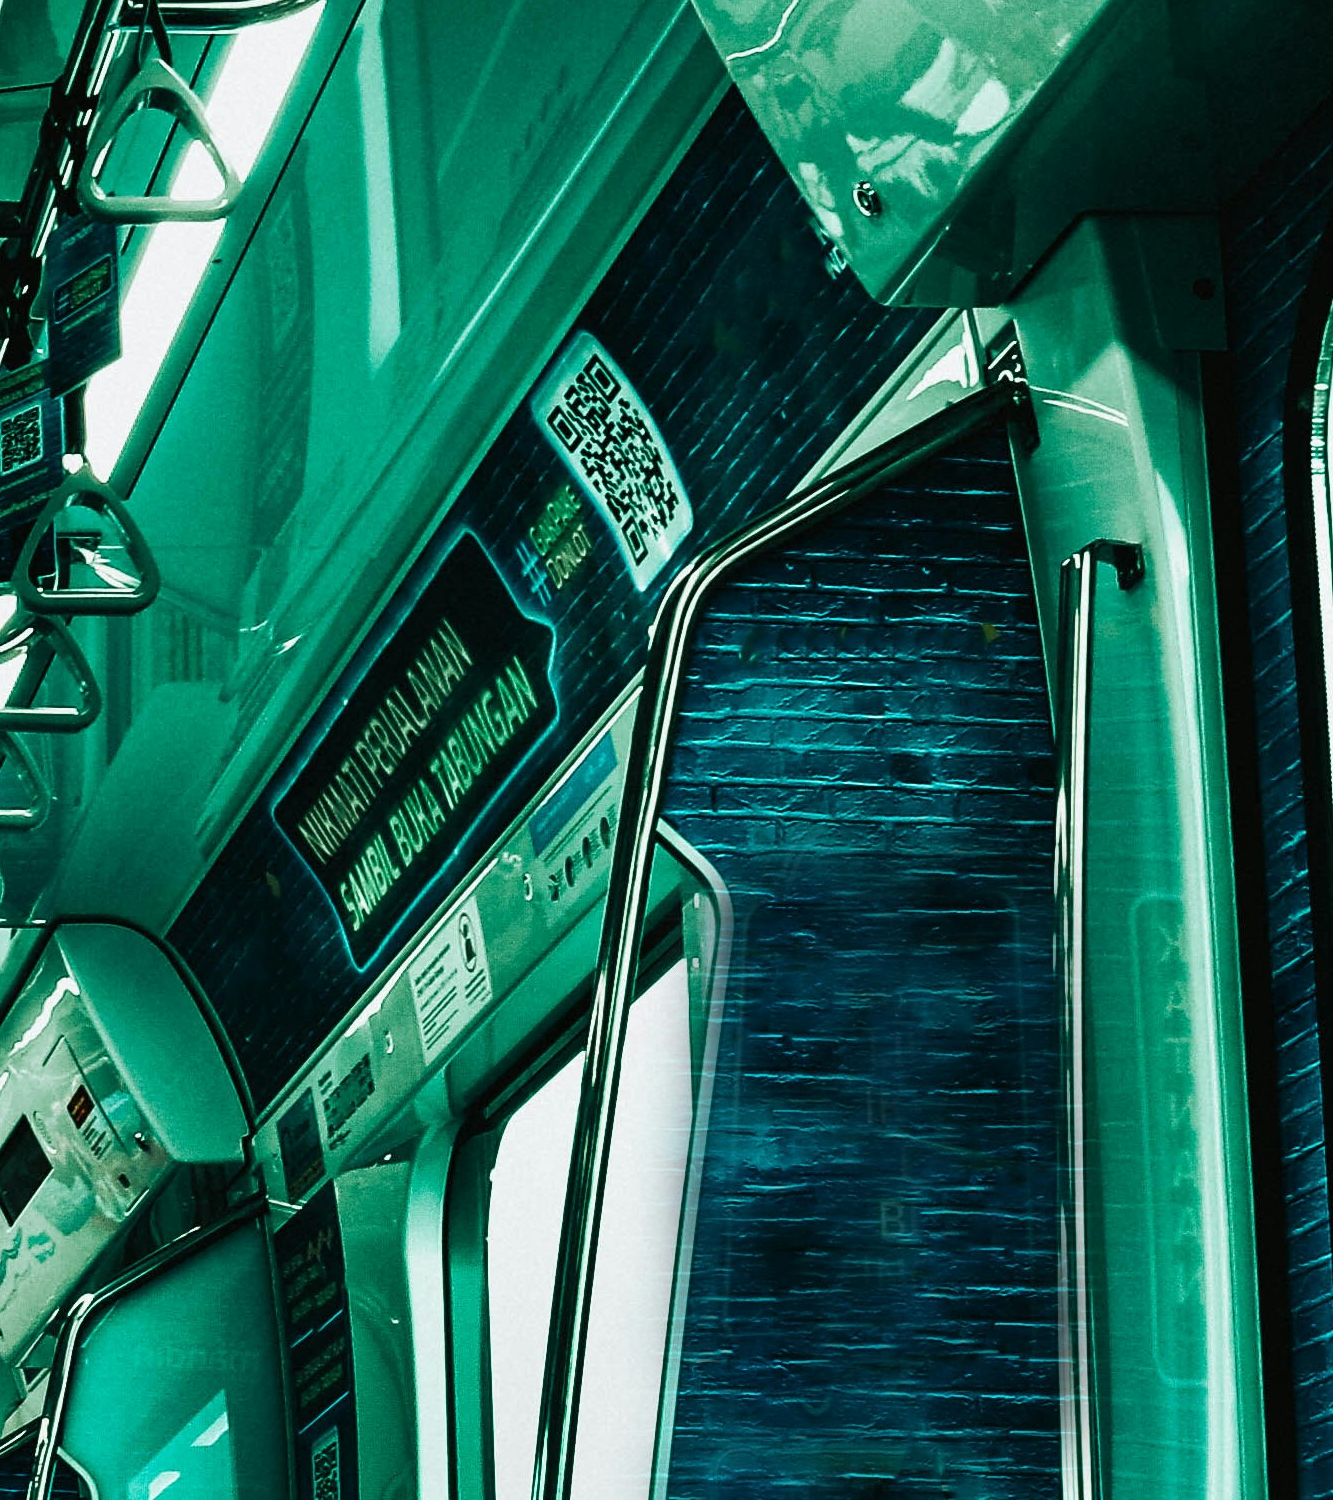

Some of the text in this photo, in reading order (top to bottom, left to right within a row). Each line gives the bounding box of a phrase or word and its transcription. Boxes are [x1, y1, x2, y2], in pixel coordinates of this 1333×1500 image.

[545, 524, 593, 590] DONLOT
[297, 617, 472, 865] NIKMATI PERJALANAN
[340, 655, 538, 932] SAMBIL BUKA TABUNGAN
